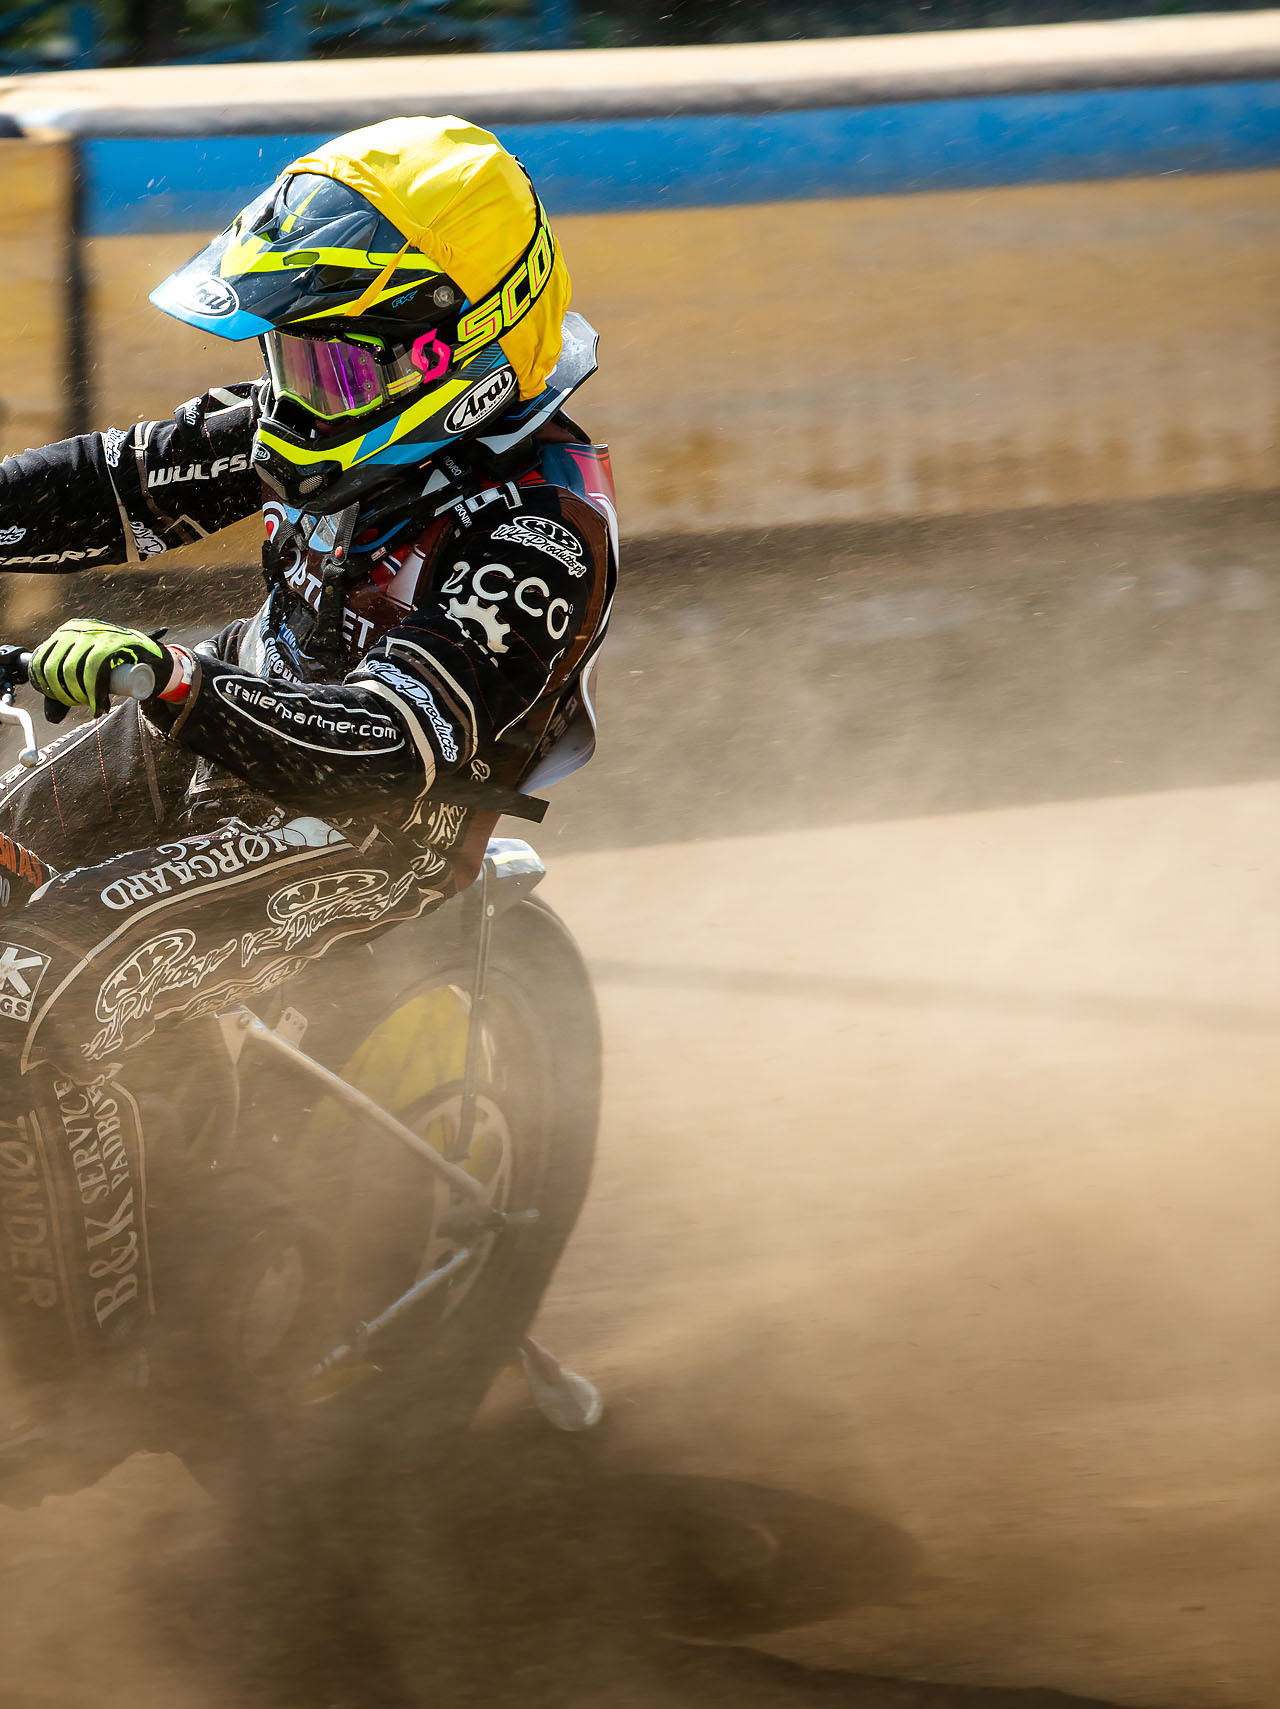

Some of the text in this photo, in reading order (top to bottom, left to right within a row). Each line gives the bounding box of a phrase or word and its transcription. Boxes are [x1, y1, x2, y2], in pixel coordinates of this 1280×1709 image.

[455, 371, 509, 429] Arai
[148, 453, 254, 487] WULFS
[224, 680, 397, 740] trailerpartner.com
[53, 1080, 112, 1205] SERVICE
[84, 1187, 141, 1329] B&K
